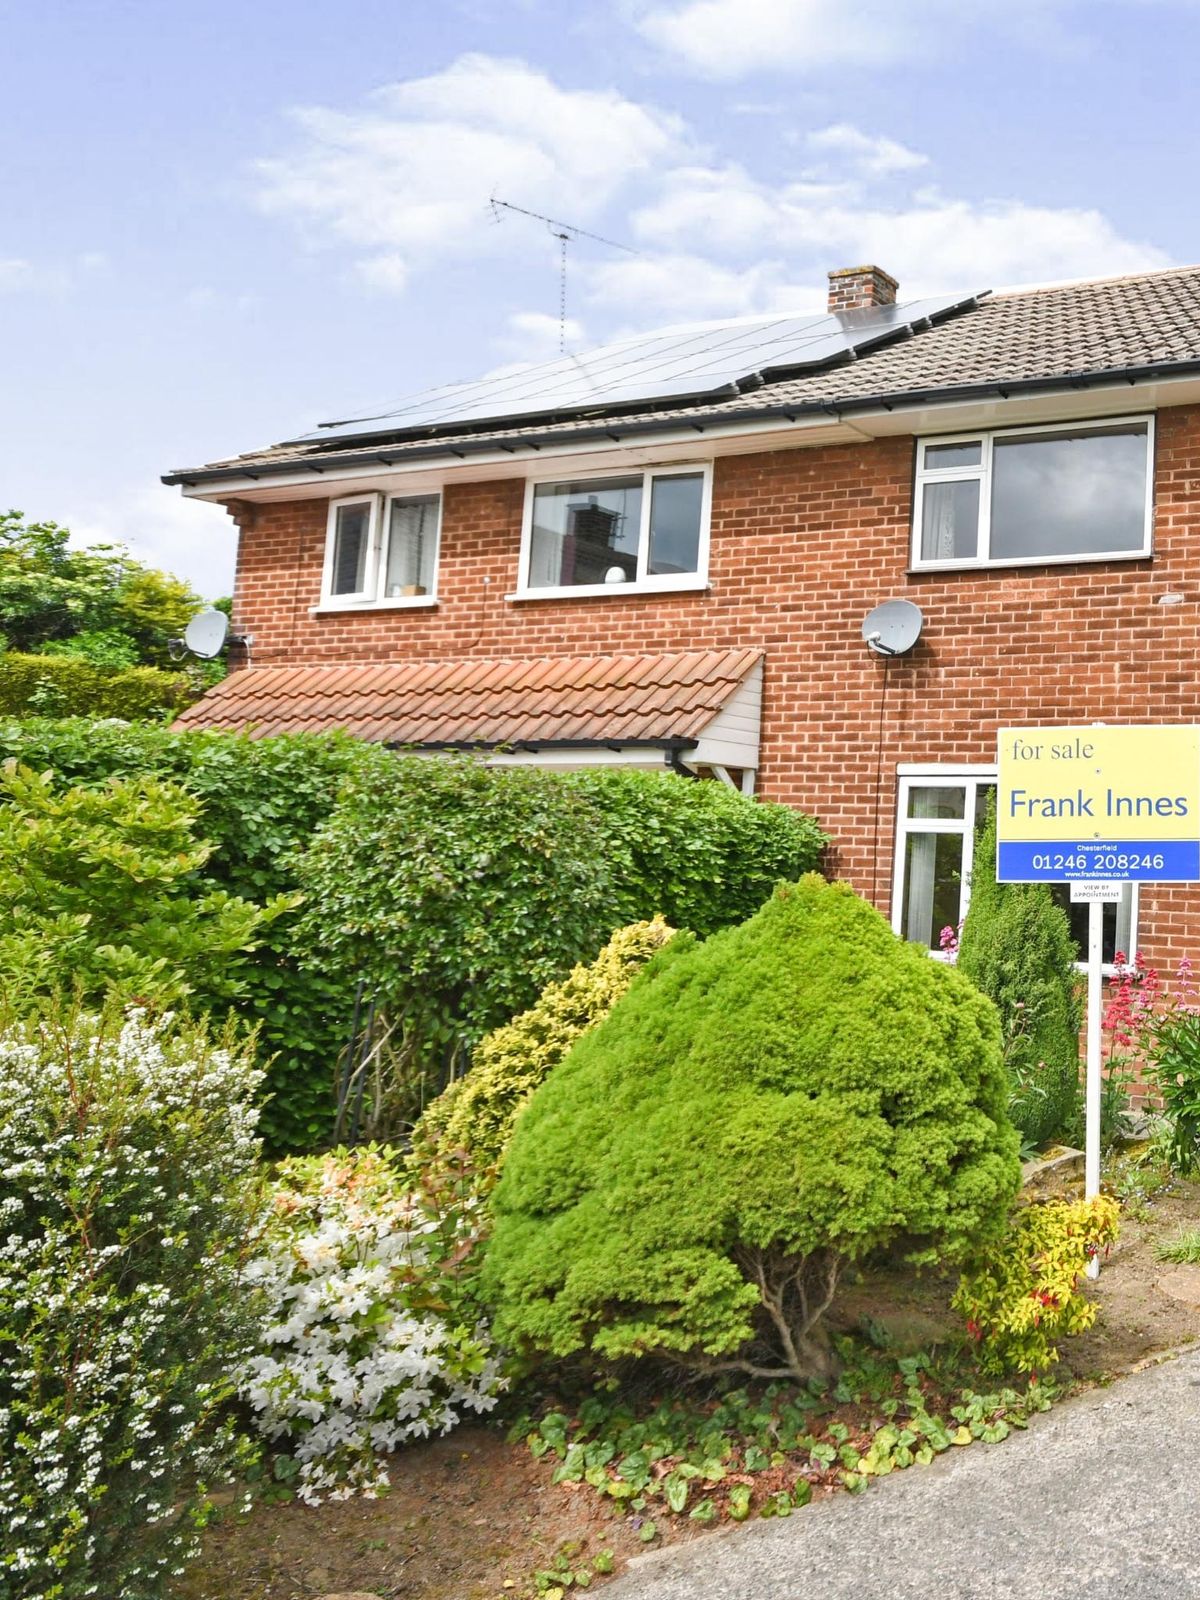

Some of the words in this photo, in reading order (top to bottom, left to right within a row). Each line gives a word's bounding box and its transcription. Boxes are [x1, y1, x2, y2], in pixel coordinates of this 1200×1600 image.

[1012, 739, 1043, 760] for
[1050, 738, 1094, 759] sale
[1010, 789, 1094, 817] Frank
[1107, 789, 1188, 816] Innes
[1032, 854, 1087, 870] 01246
[1094, 854, 1164, 870] 208246
